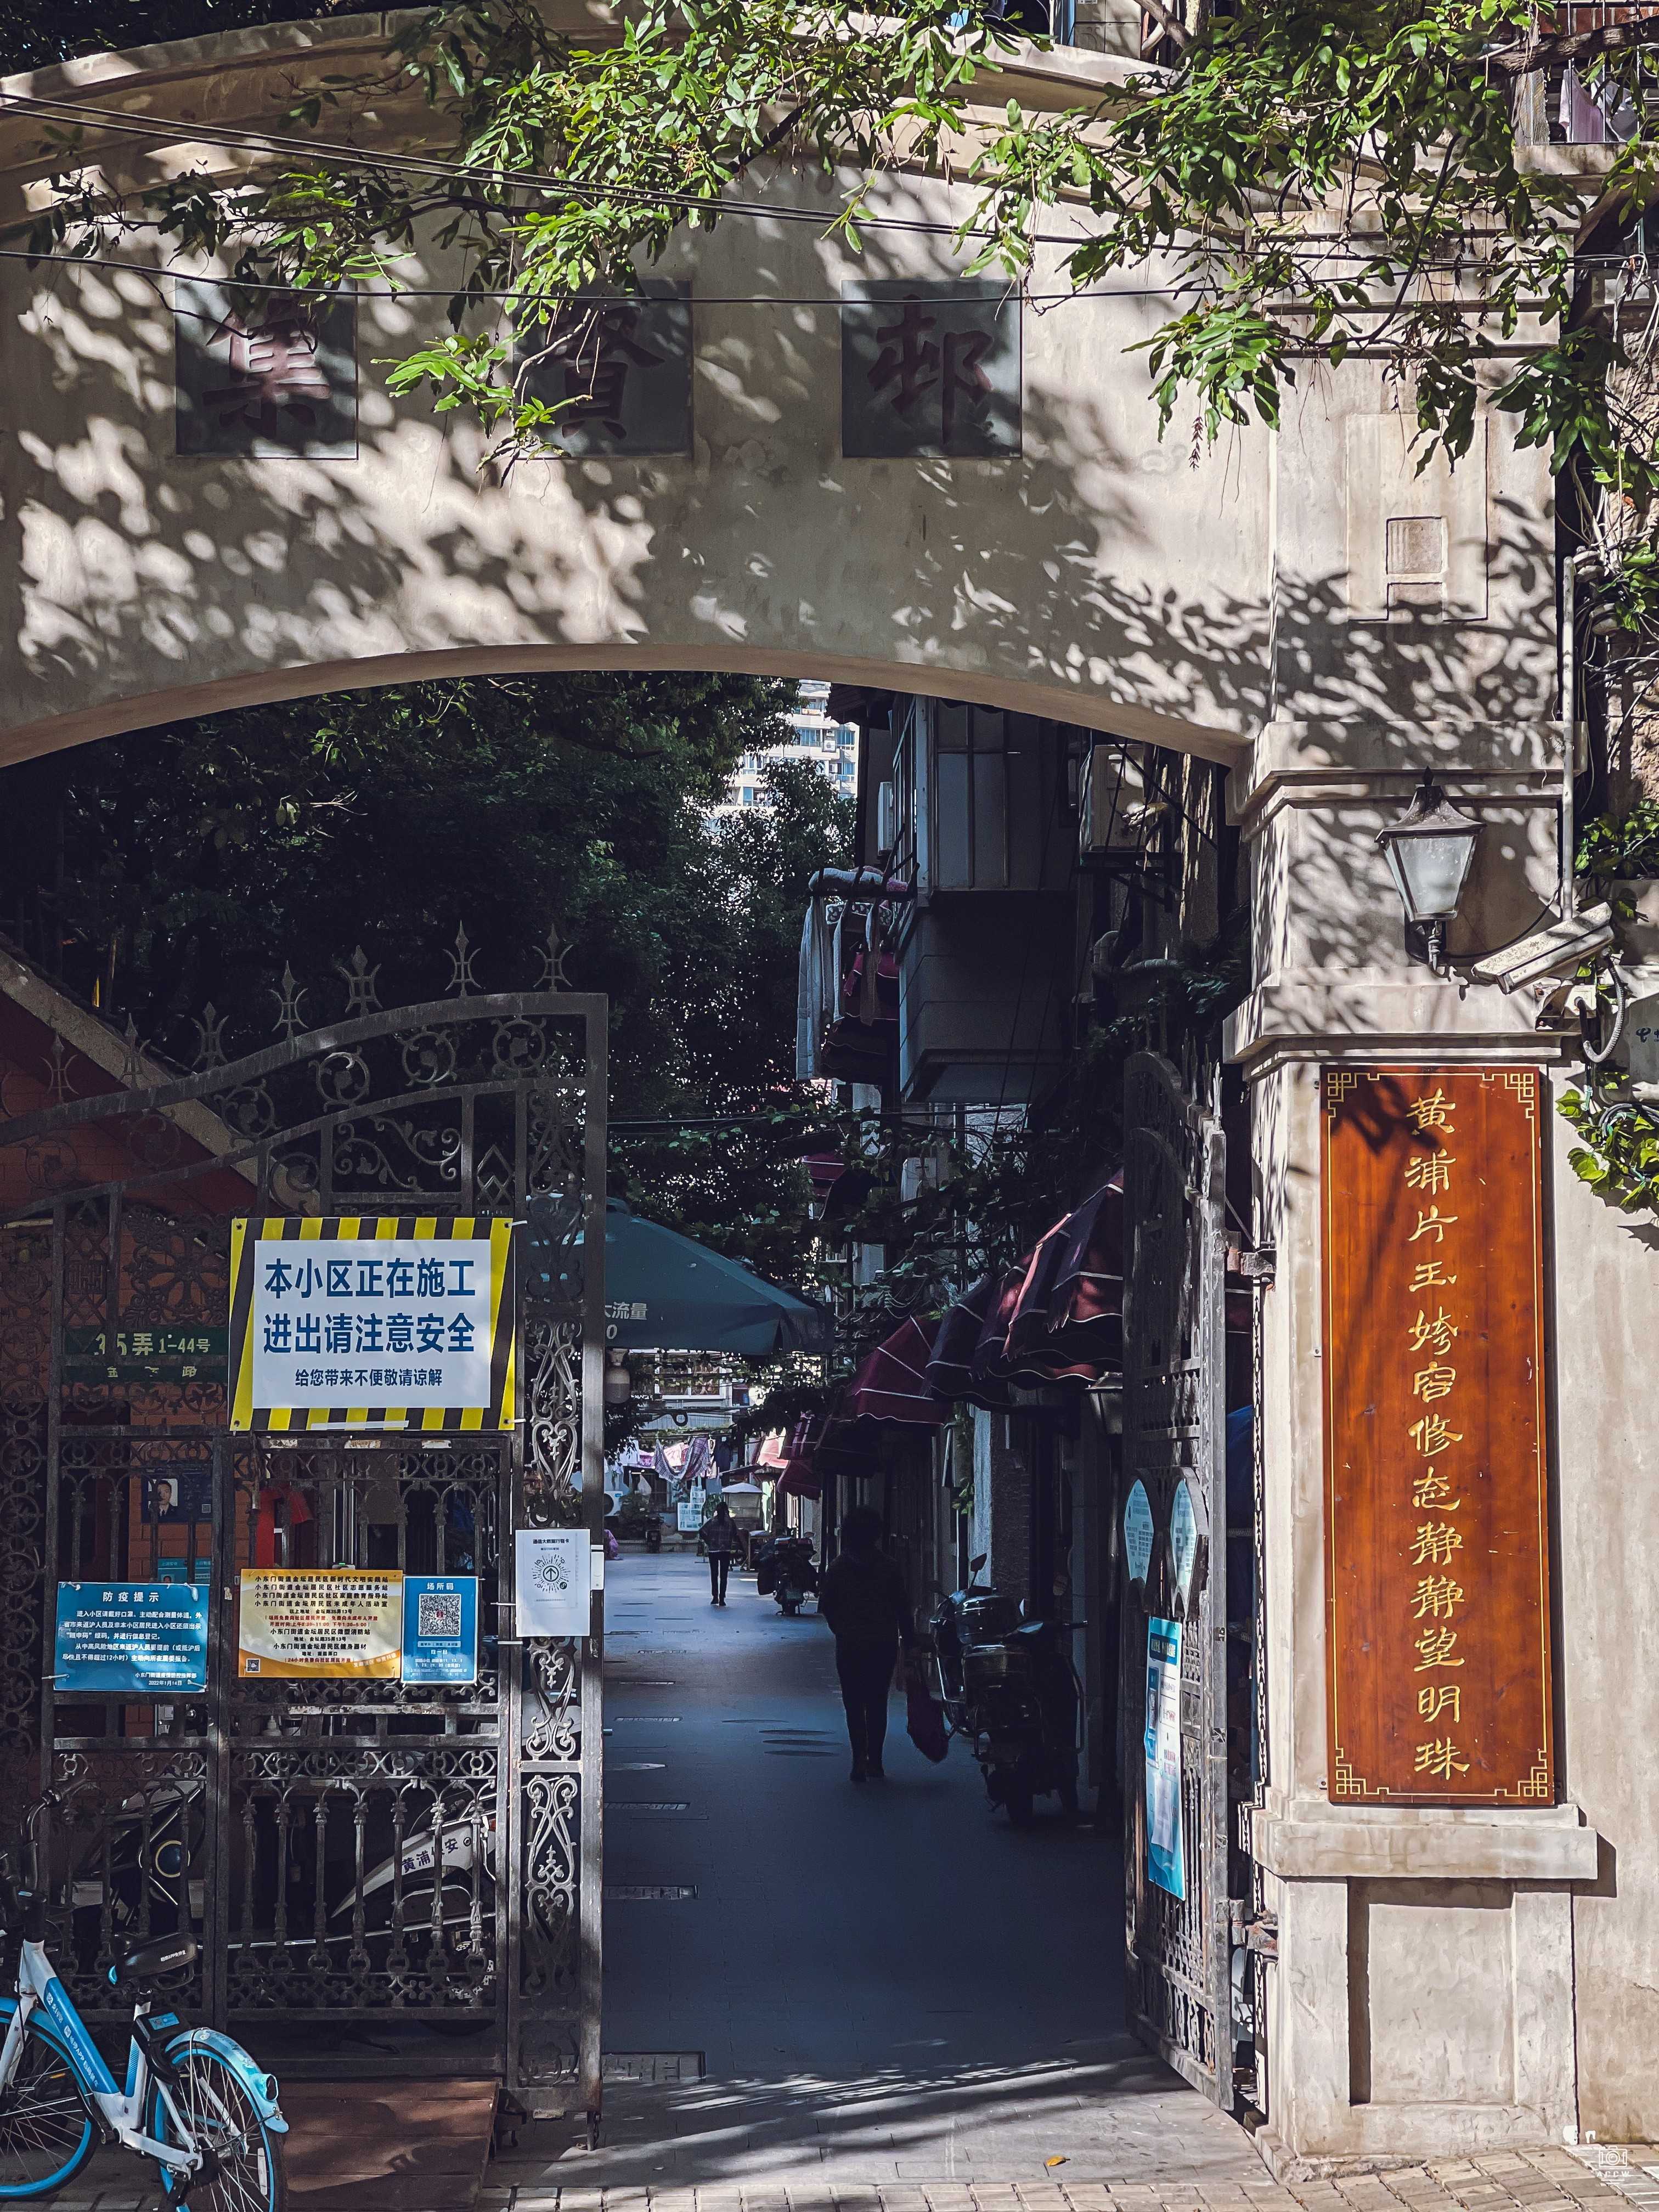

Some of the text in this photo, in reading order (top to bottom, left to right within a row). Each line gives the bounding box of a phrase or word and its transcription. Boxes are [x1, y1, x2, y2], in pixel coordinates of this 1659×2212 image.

[264, 1257, 476, 1299] 本小区正在施工
[263, 1312, 475, 1354] 进出请注意安全
[295, 1368, 443, 1387] 给您带来不便敬请谅解
[427, 1582, 454, 1590] 场所码
[103, 1592, 159, 1602] 防疫提示
